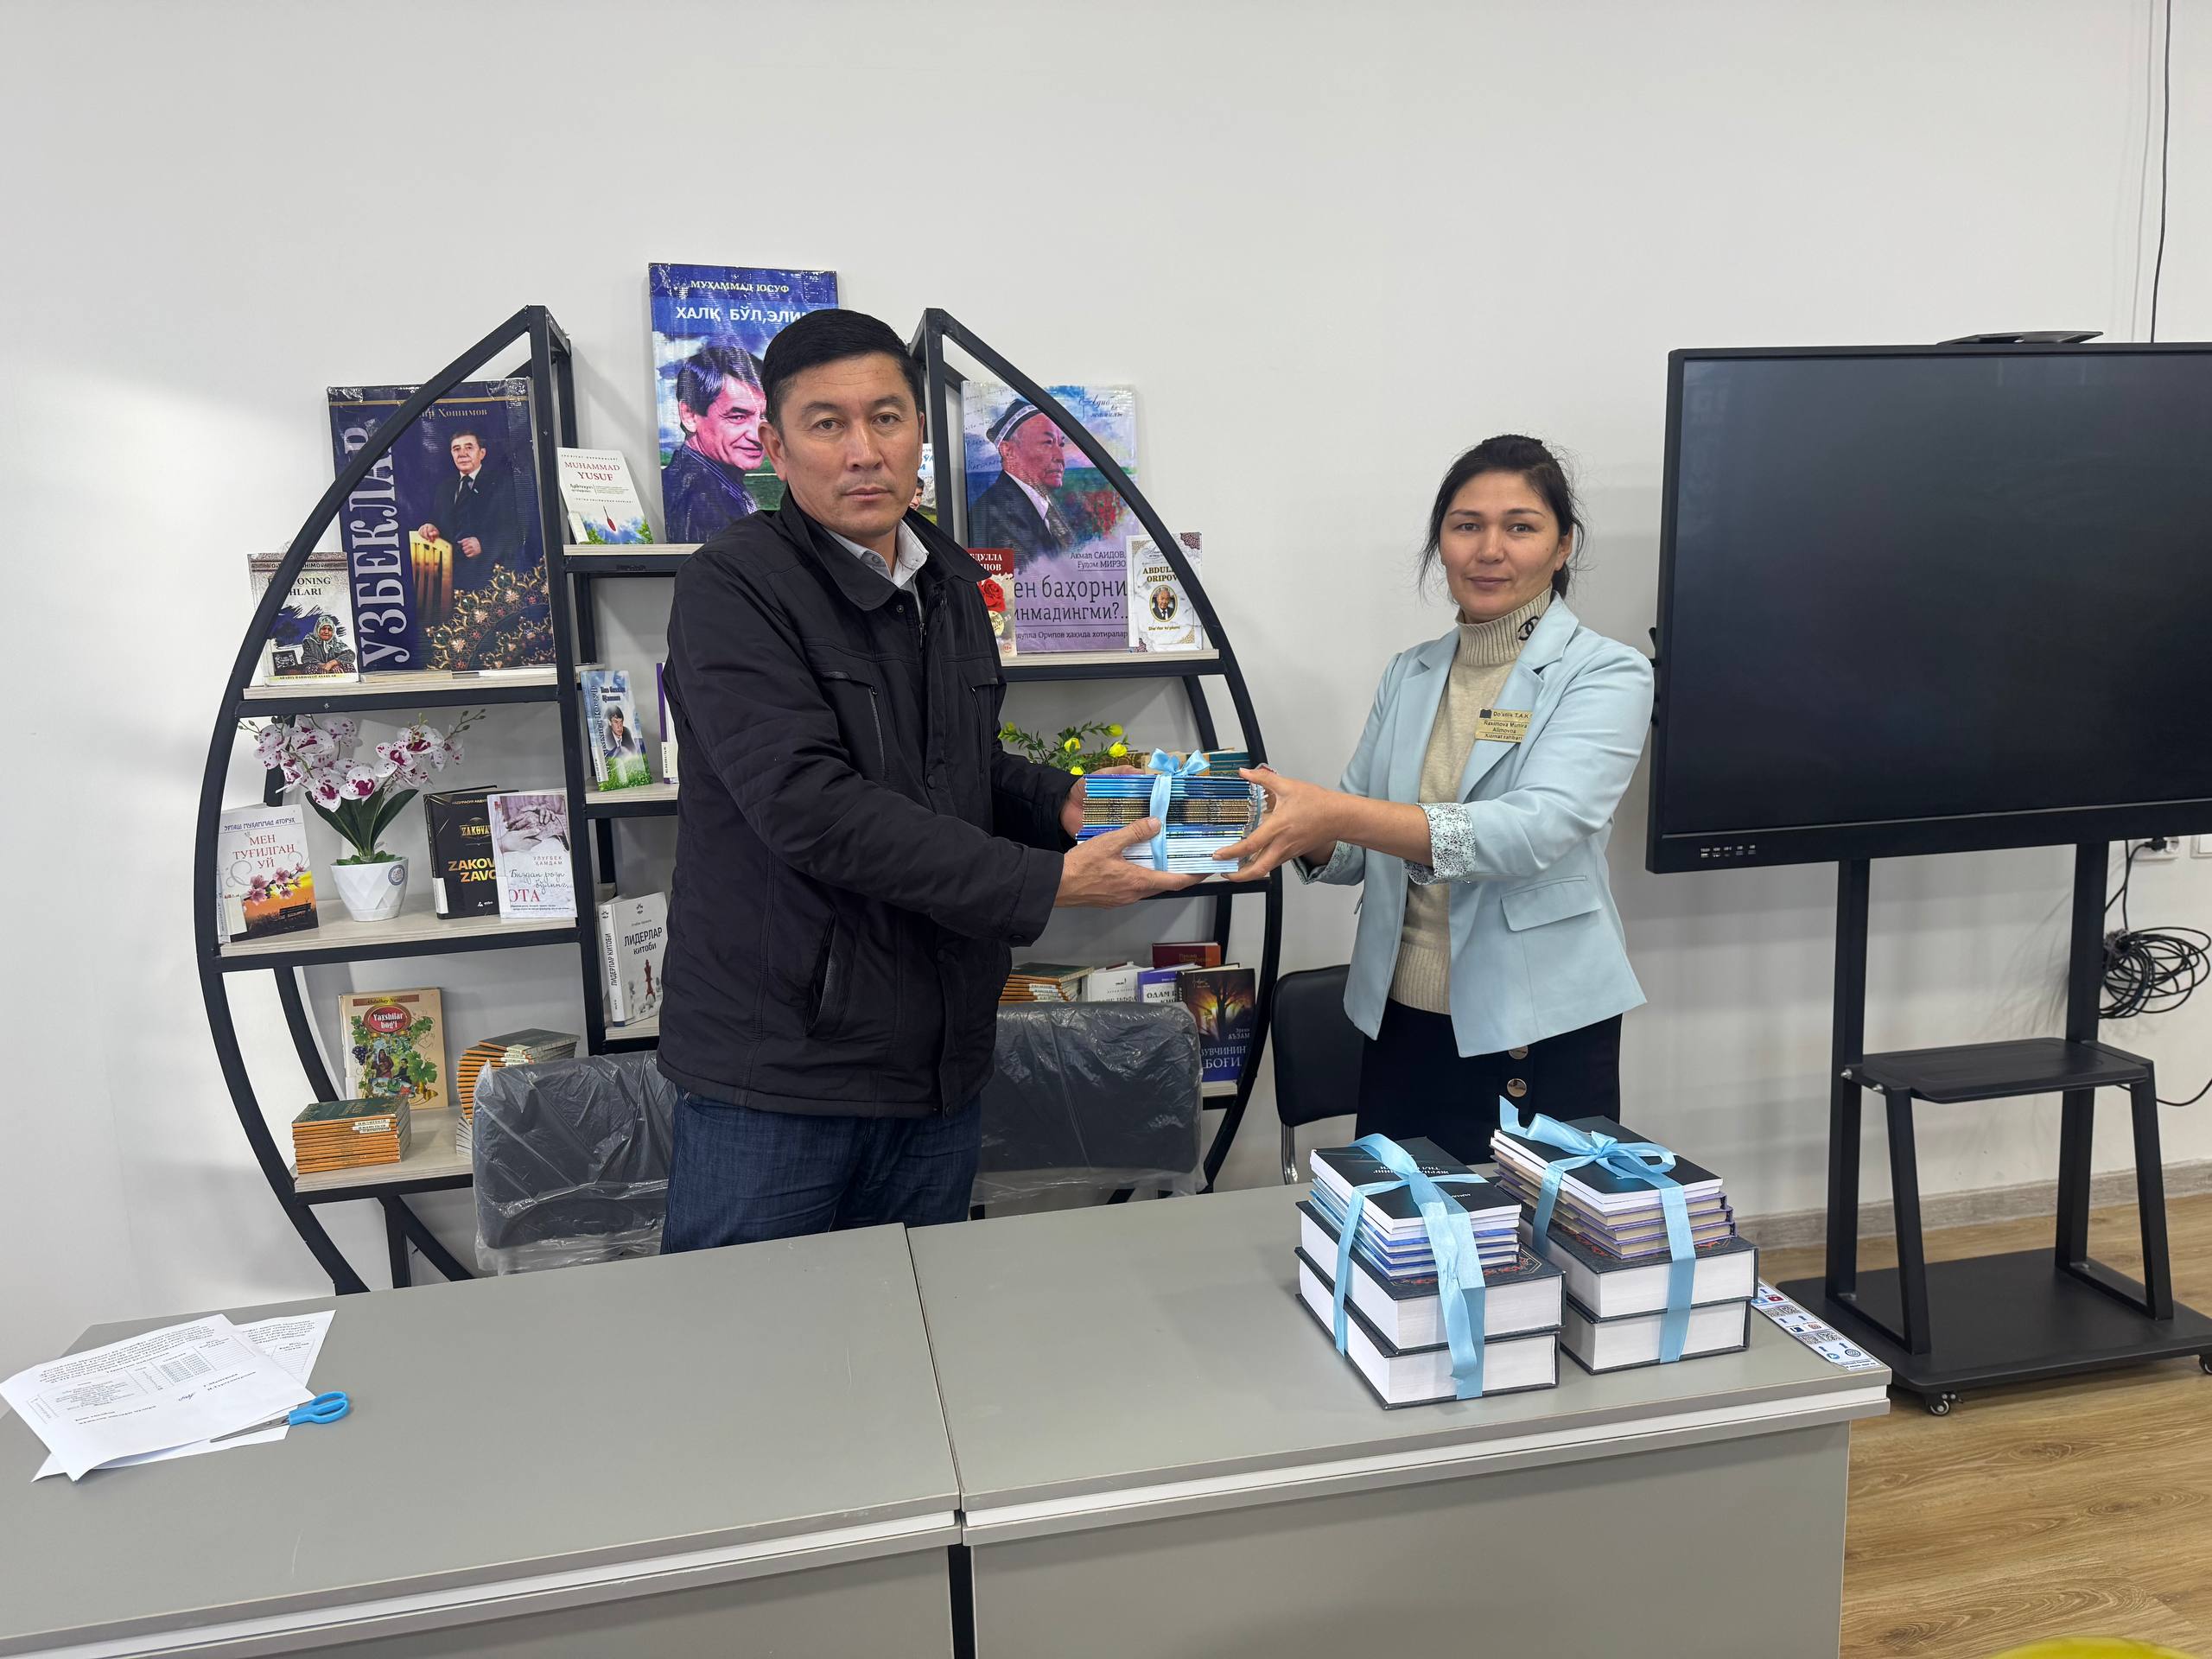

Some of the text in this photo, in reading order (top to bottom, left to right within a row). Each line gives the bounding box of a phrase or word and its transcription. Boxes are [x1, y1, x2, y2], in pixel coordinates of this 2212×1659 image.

[757, 283, 790, 293] ЮСУФ
[676, 306, 810, 324] ХАЛҚ БЎЛ,ЭЛИ
[564, 461, 620, 471] MUHAMMAD
[577, 472, 614, 481] YUSUF
[969, 553, 1002, 563] БДУЛЛА
[1142, 566, 1175, 575] ABDUL
[289, 588, 322, 596] HLARI
[1014, 575, 1128, 603] ен баҳорни
[461, 825, 490, 836] ZAKOVA
[250, 834, 276, 846] МЕН
[232, 843, 295, 860] ТУҒИЛГАН
[257, 857, 274, 868] УЙ
[448, 858, 495, 871] ZAKOV
[509, 889, 540, 902] ОТА
[624, 927, 663, 947] ЛИДЕРЛАР
[1147, 990, 1170, 999] ОДАМ
[373, 1013, 404, 1021] Yaxshilar
